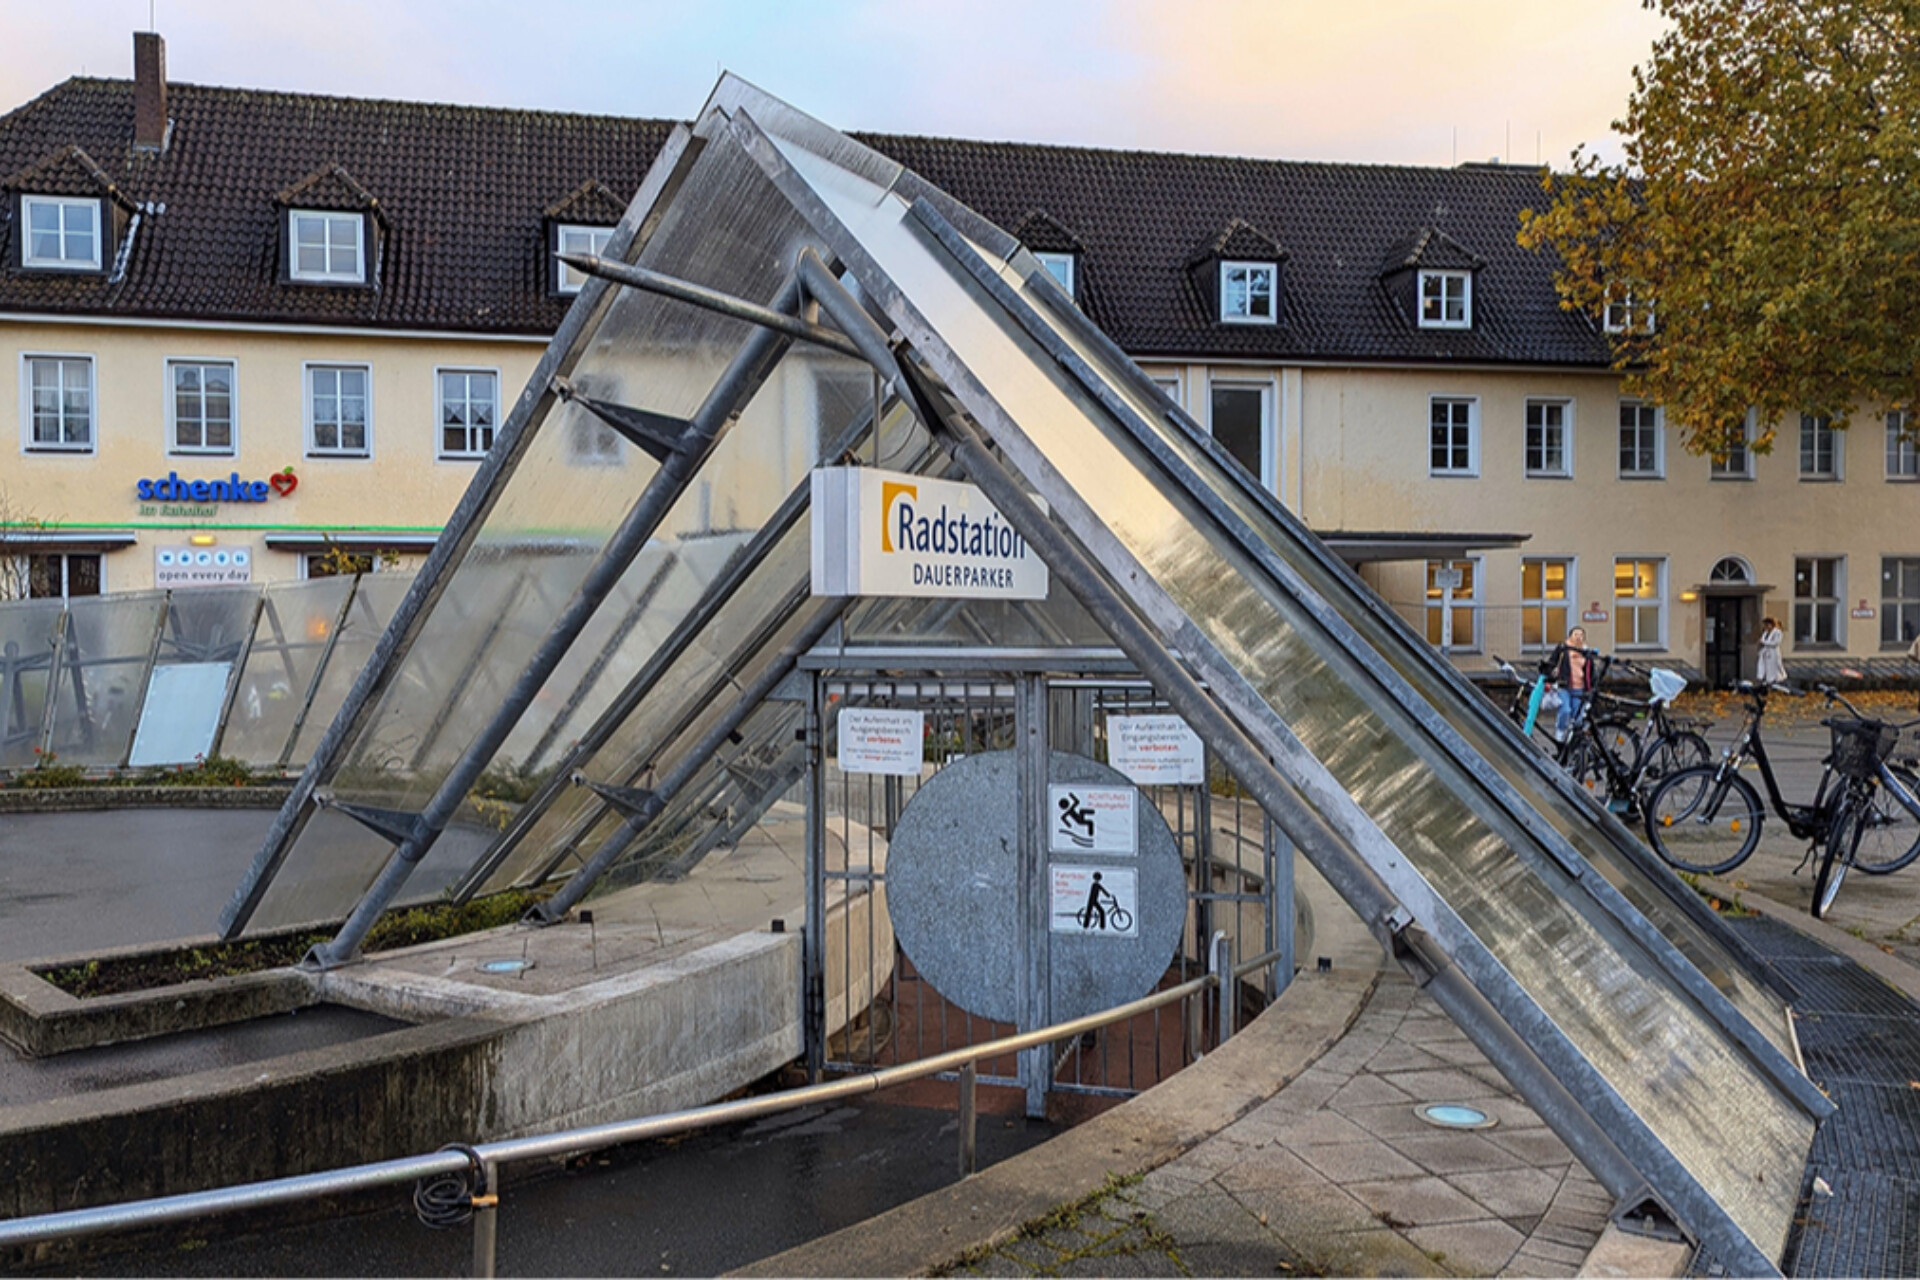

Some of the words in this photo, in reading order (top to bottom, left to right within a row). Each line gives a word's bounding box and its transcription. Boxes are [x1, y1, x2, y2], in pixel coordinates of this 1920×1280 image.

[137, 471, 269, 502] schenke
[898, 502, 1026, 560] Radstation
[159, 571, 188, 581] open
[192, 571, 225, 581] every
[228, 570, 249, 581] day
[913, 563, 1014, 588] DAUERPARKER
